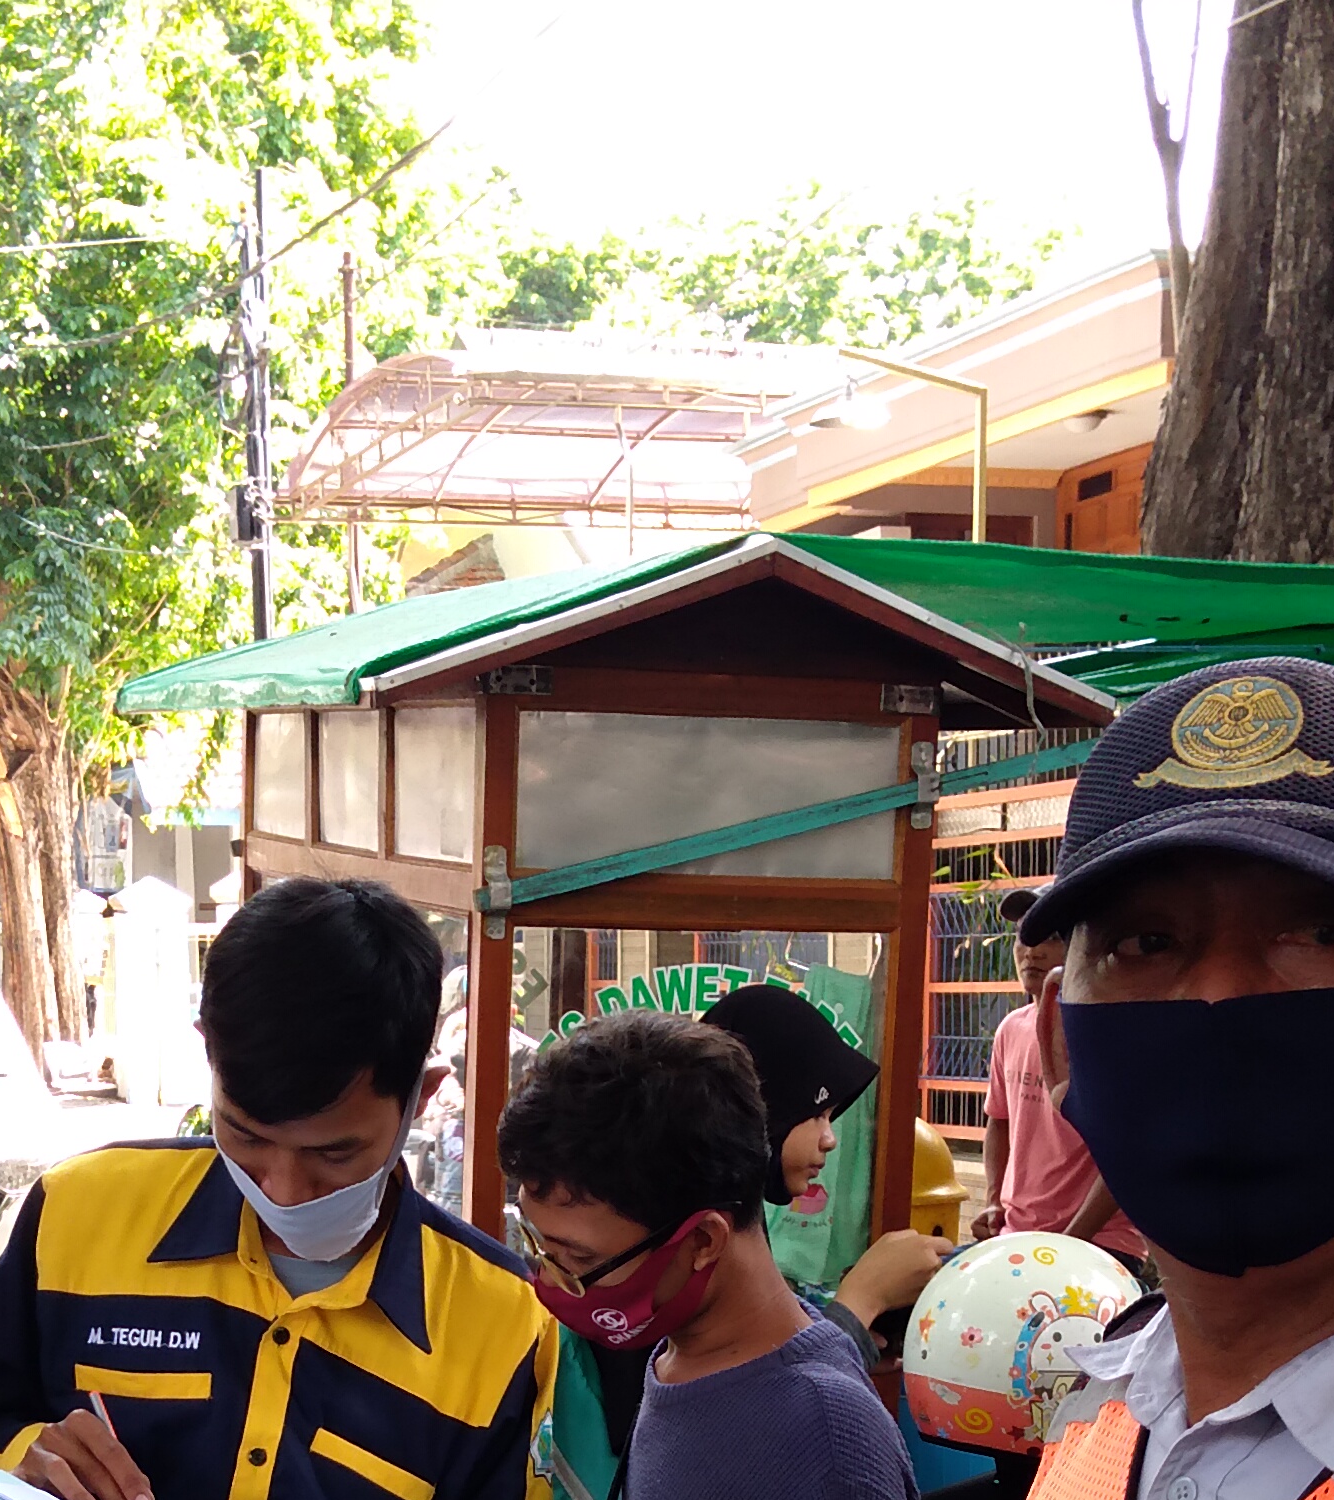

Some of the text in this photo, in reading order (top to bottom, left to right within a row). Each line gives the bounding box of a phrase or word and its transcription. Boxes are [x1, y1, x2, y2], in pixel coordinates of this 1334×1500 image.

[593, 962, 753, 1018] DAWET
[111, 1327, 163, 1348] TEGUH
[167, 1331, 201, 1350] D.W
